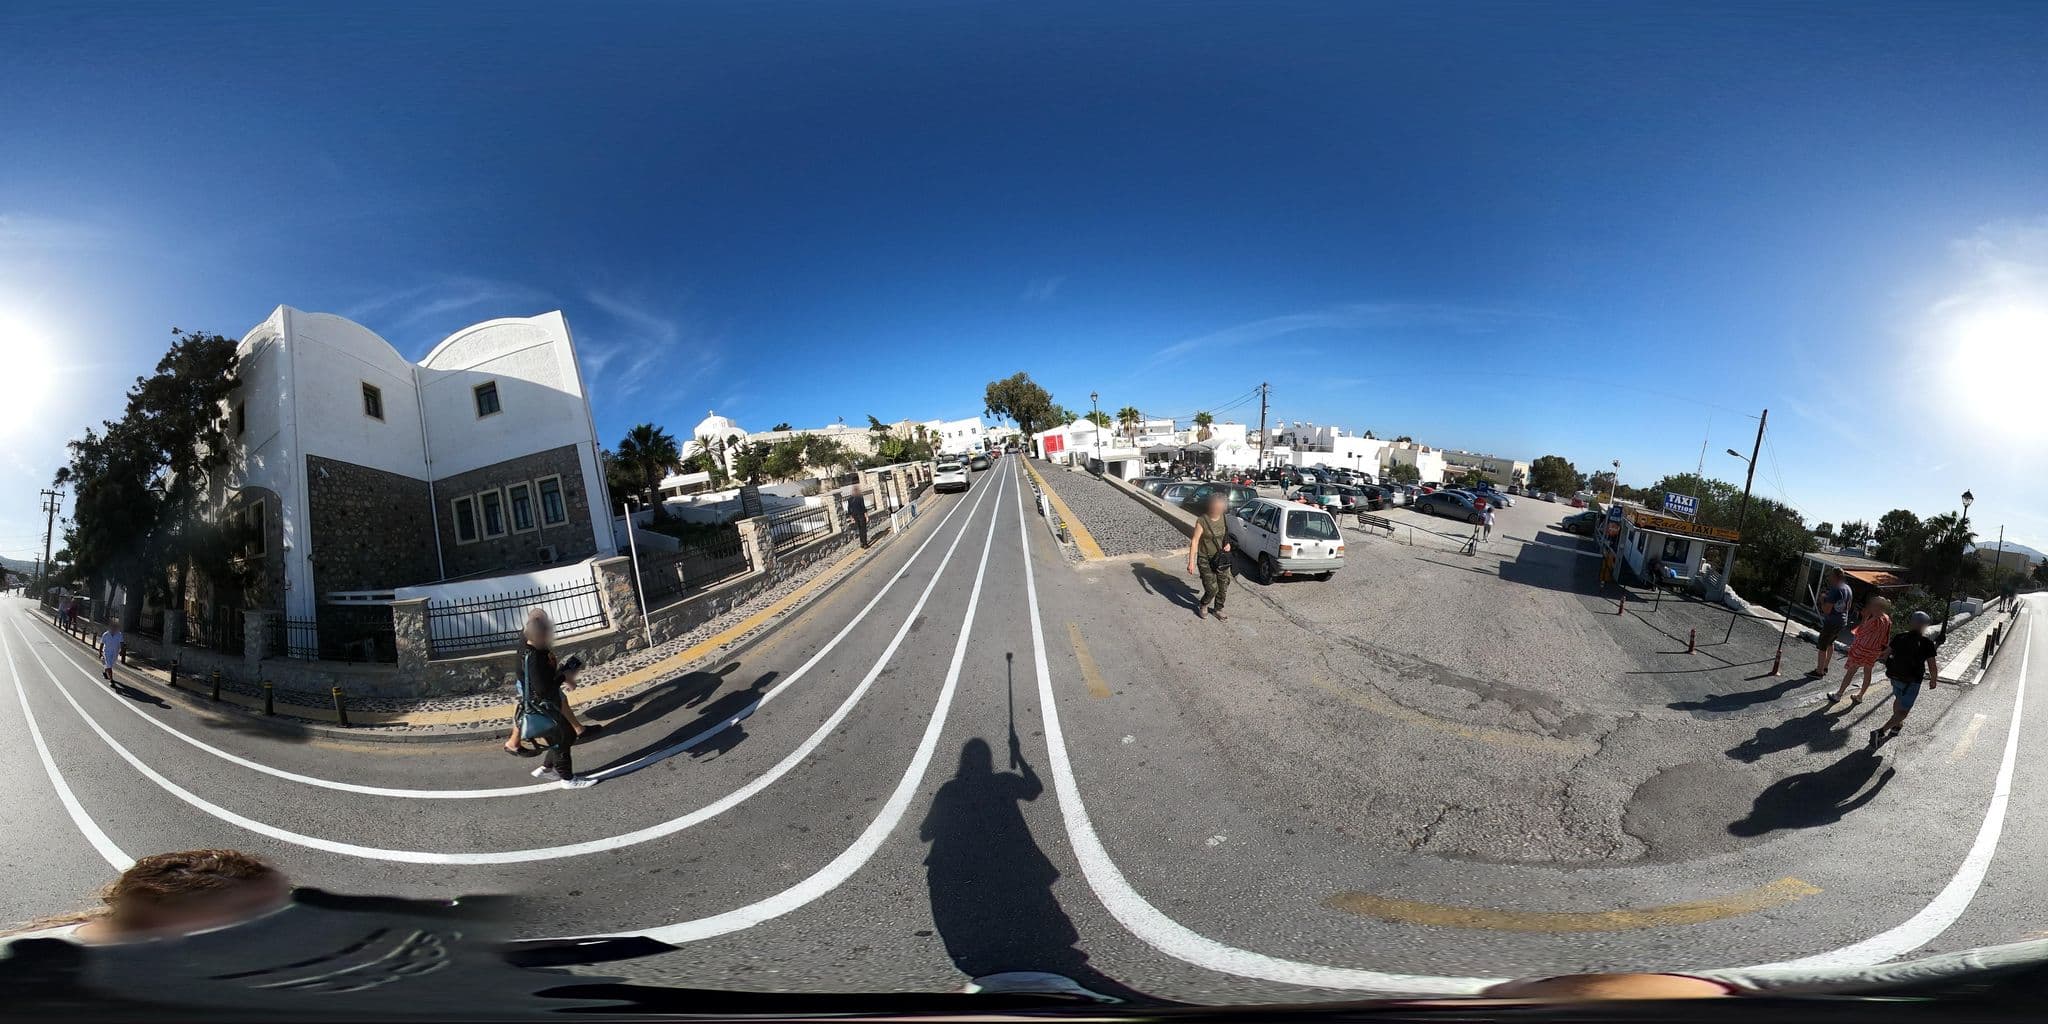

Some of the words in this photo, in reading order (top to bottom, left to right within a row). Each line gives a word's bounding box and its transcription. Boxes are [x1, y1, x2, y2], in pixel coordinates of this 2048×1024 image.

[1668, 494, 1693, 507] TAXI
[1665, 502, 1694, 514] STATION
[1651, 517, 1687, 531] Radio
[1691, 524, 1713, 535] TAXI
